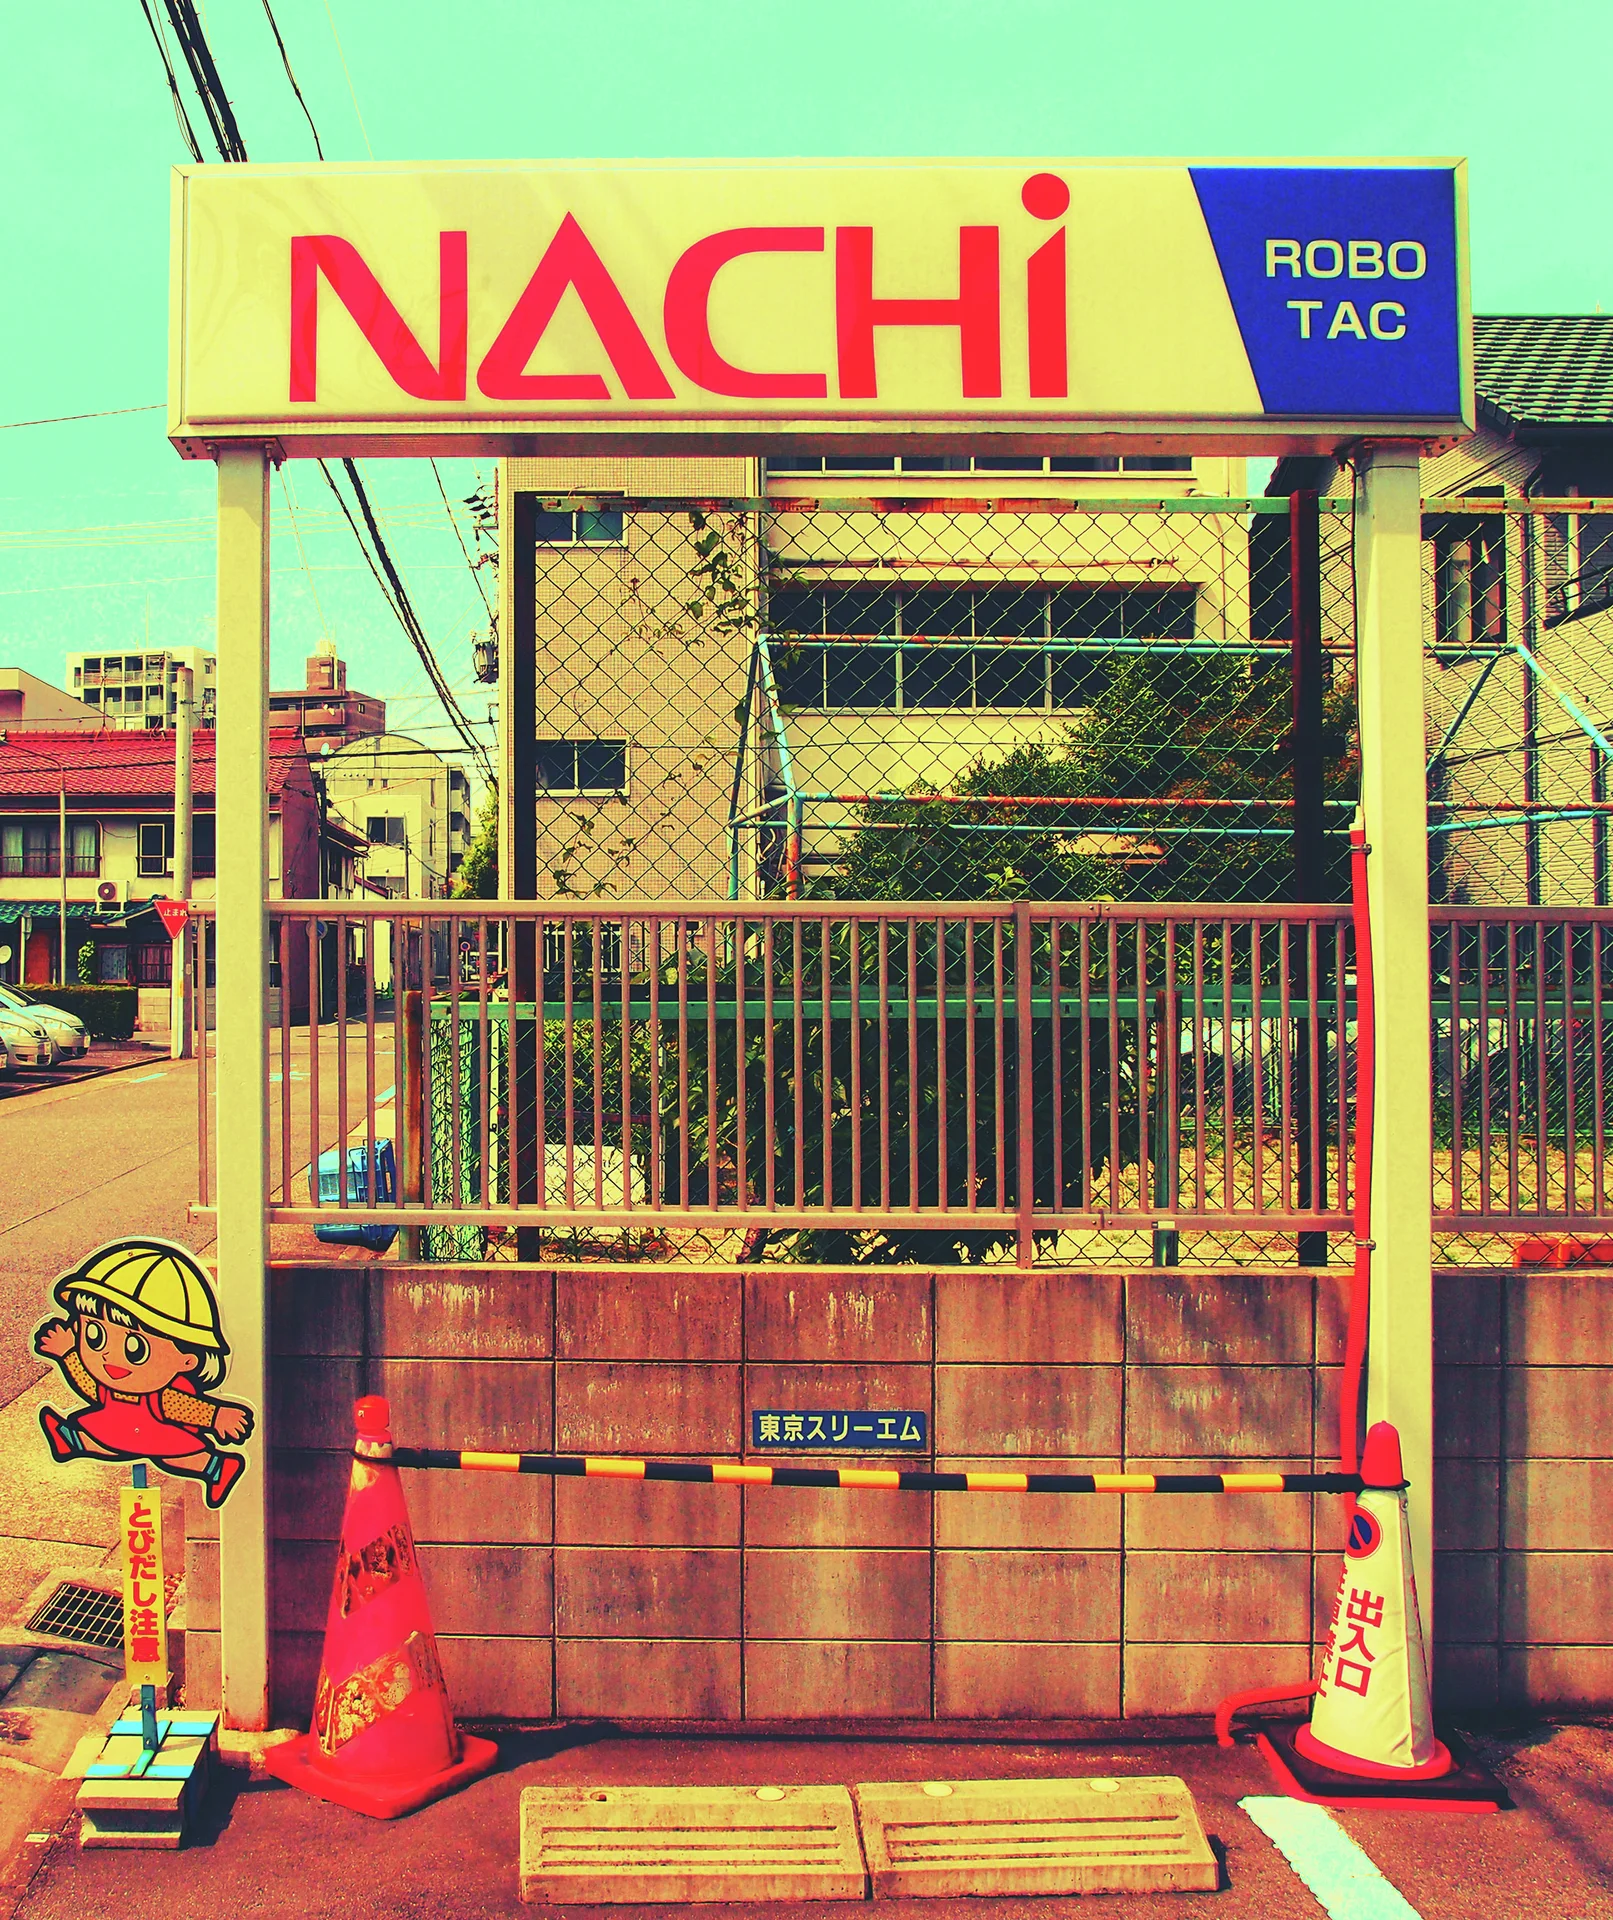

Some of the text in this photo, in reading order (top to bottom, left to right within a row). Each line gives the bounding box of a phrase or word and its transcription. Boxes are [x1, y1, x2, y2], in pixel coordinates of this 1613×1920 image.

[1265, 239, 1428, 280] ROBO
[1287, 300, 1407, 341] TAC
[759, 1413, 921, 1442] 東京スリーエム
[127, 1502, 161, 1663] とびだし注意
[1334, 1587, 1385, 1698] 出入口
